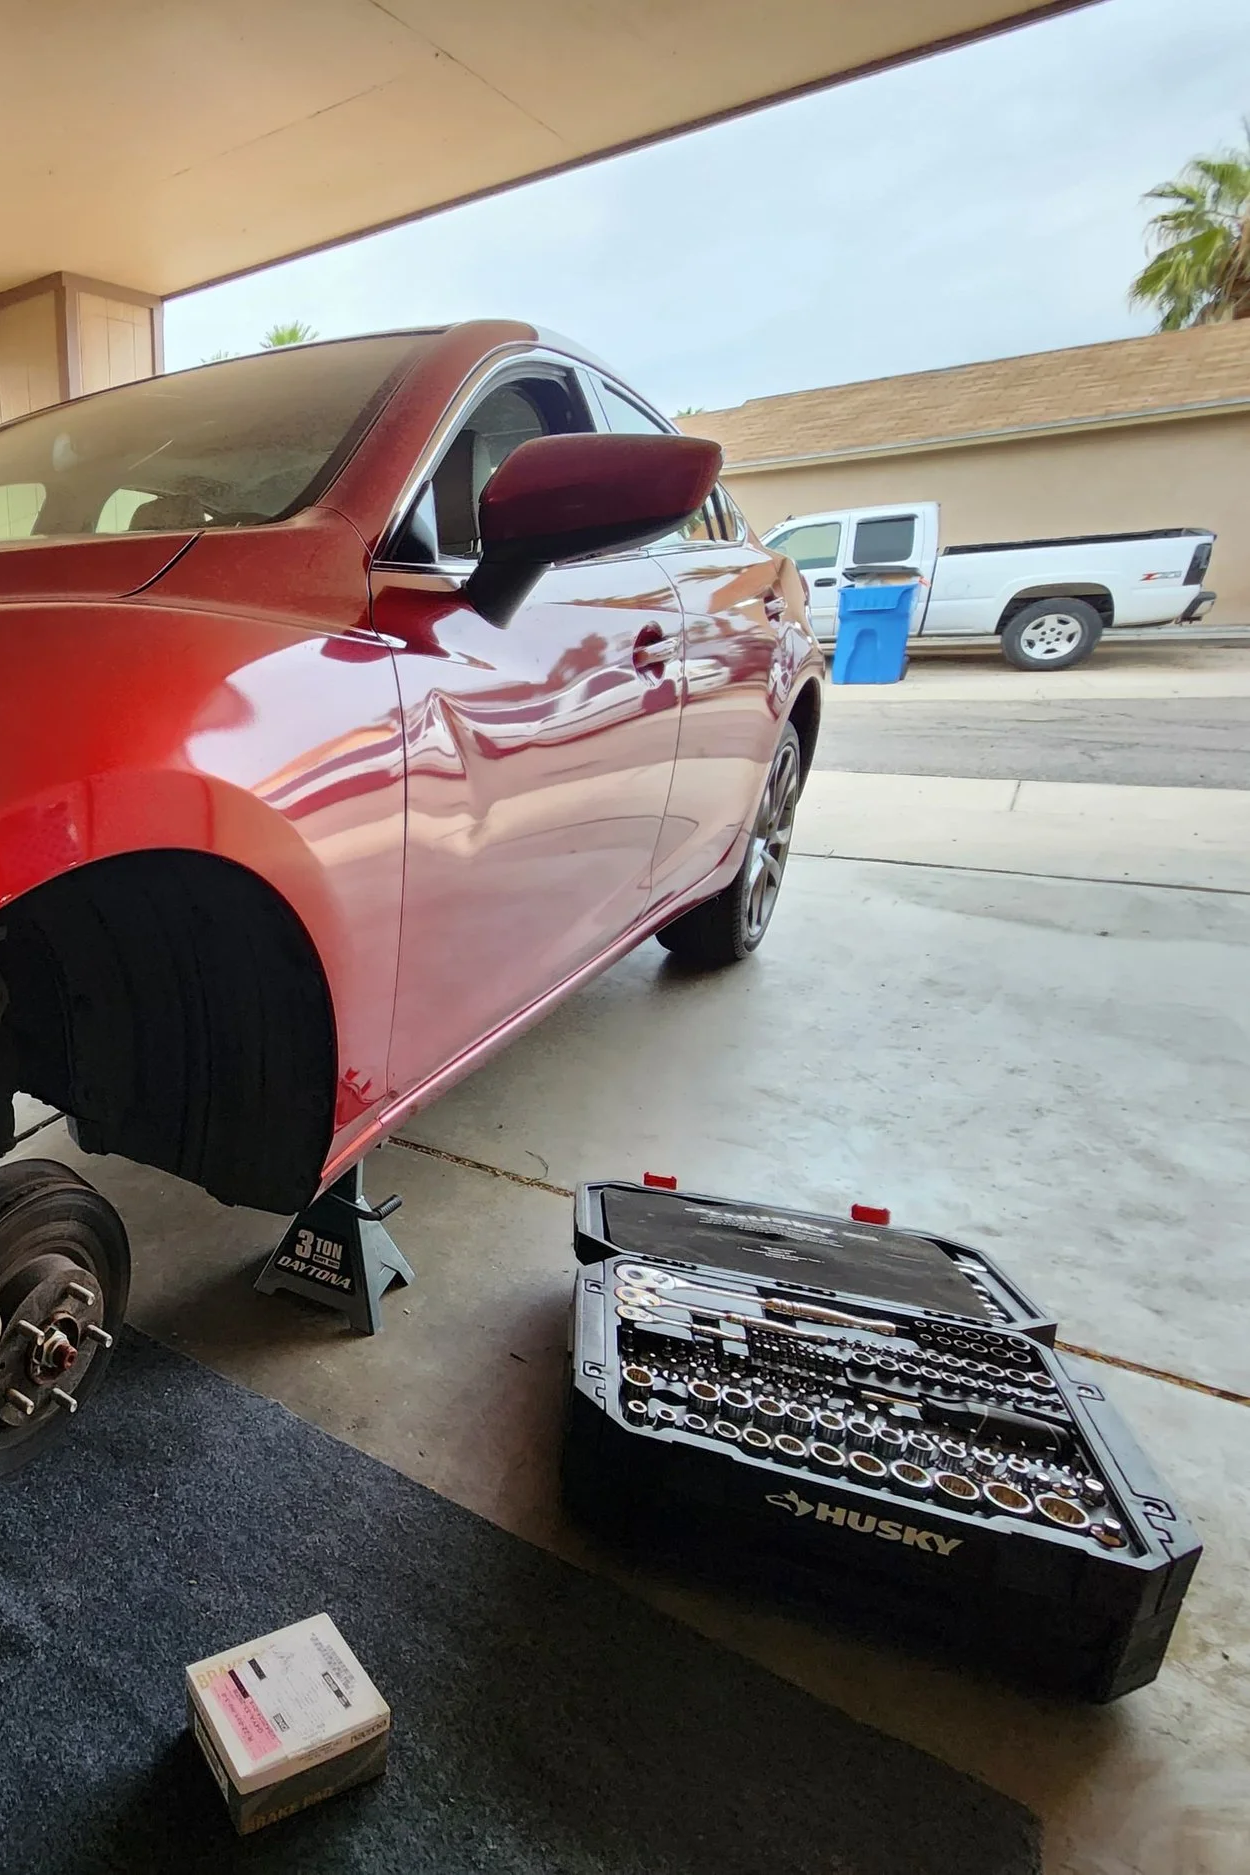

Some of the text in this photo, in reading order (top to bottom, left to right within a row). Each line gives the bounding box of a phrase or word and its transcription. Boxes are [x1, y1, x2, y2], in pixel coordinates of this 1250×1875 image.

[295, 1229, 342, 1260] 3 TON
[277, 1256, 351, 1289] DAYTONA
[815, 1502, 963, 1556] HUSKY
